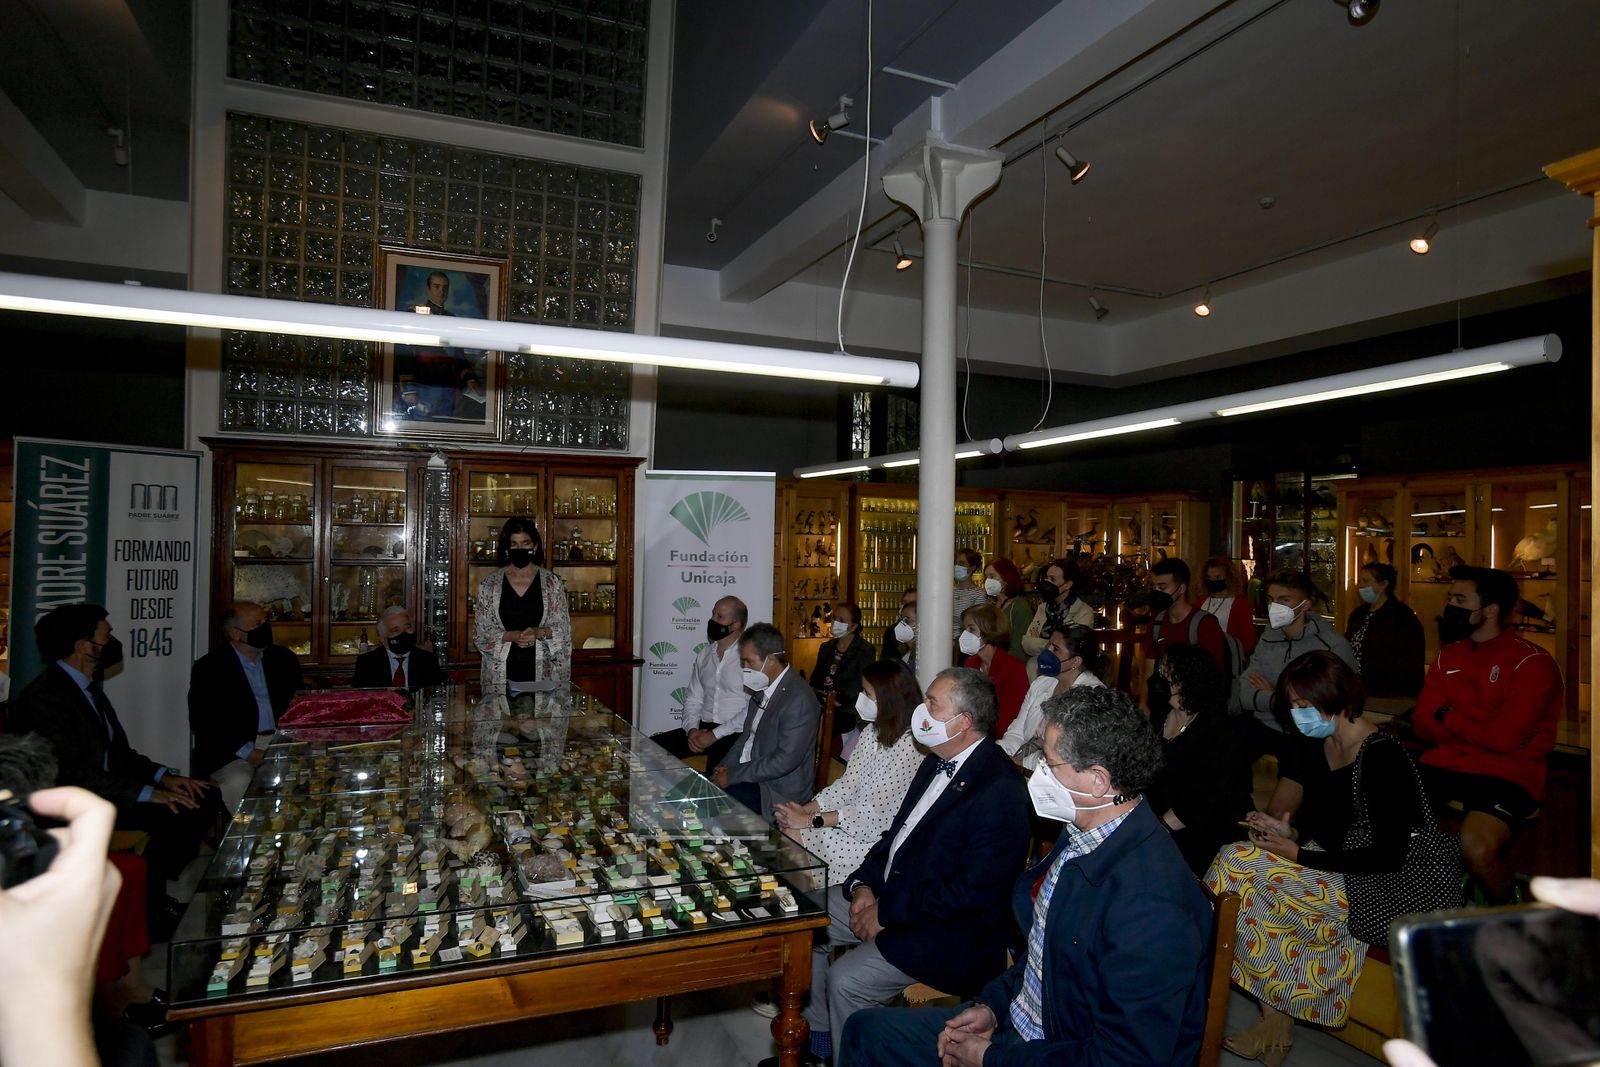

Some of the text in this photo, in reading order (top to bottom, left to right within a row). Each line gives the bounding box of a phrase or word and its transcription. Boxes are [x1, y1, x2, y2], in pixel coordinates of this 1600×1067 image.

[27, 455, 90, 624] ADRE SUÁREZ
[114, 540, 191, 562] FORMANDO
[670, 549, 749, 562] Fundación
[126, 569, 179, 591] FUTURO
[681, 570, 736, 587] Unicaja
[130, 598, 174, 620] DESDE
[129, 628, 173, 658] 1845
